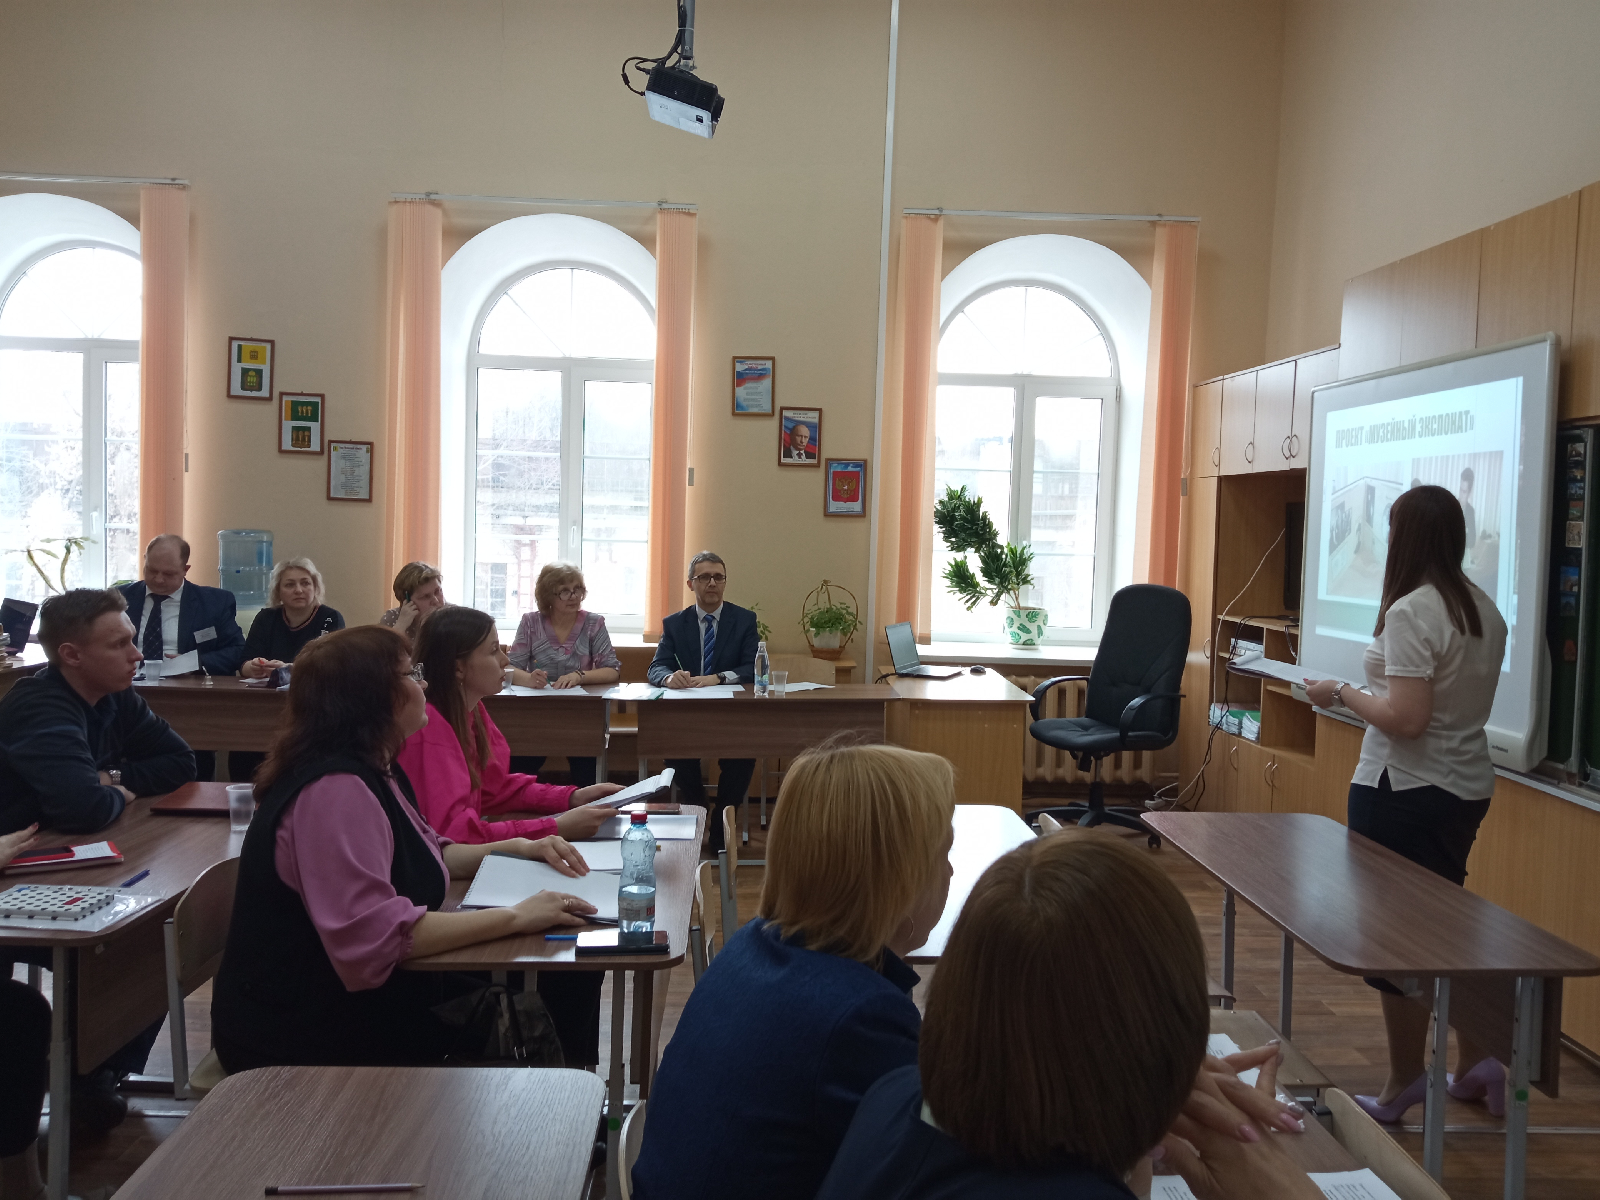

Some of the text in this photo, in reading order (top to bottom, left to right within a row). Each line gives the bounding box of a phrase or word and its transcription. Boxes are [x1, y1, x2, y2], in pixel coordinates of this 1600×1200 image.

[1335, 410, 1474, 449] ПРОЕКТ «МУЗЕЙНЫЙ ЭКСПОНАТ»
